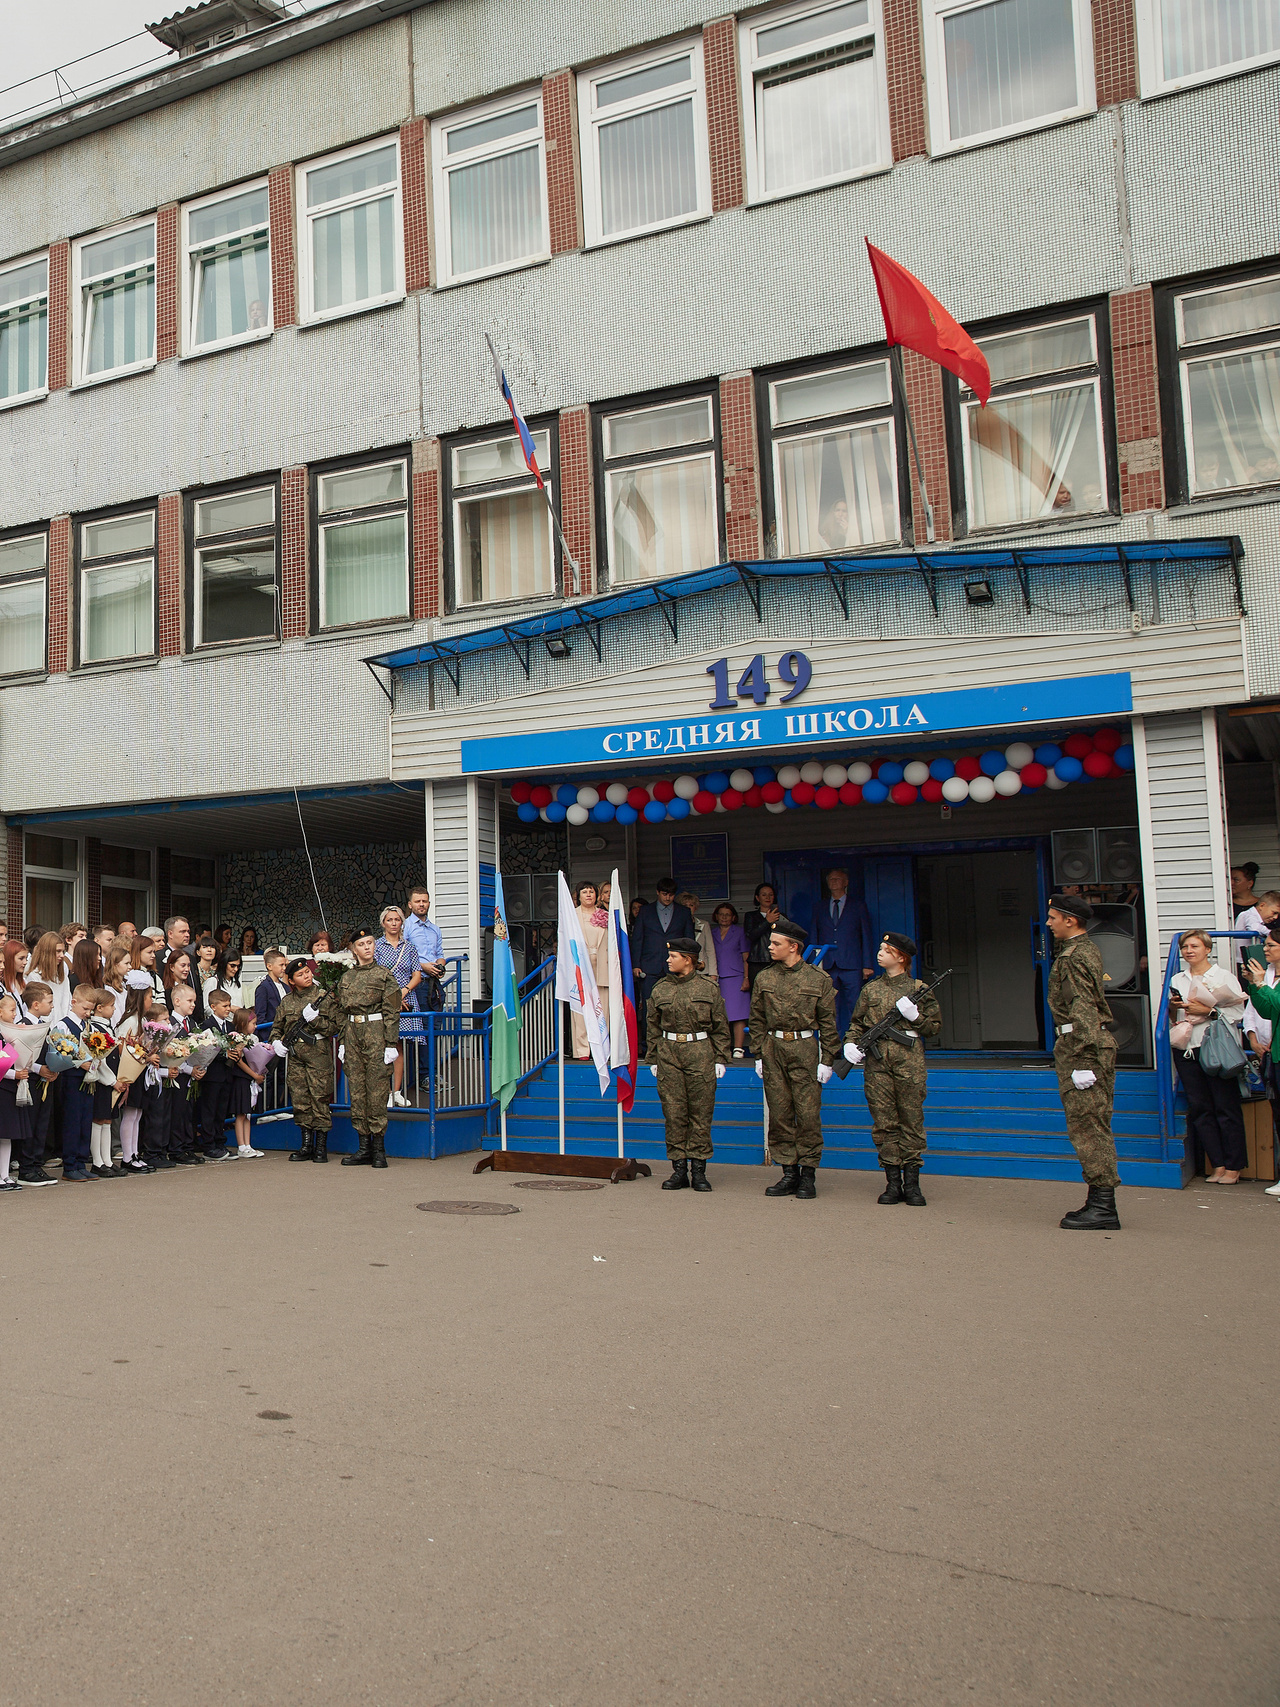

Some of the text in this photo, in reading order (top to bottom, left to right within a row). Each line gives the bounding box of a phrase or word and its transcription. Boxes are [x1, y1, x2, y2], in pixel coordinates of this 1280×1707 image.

[706, 650, 812, 710] 149
[602, 703, 929, 754] СРЕДНЯЯ ШКОЛА
